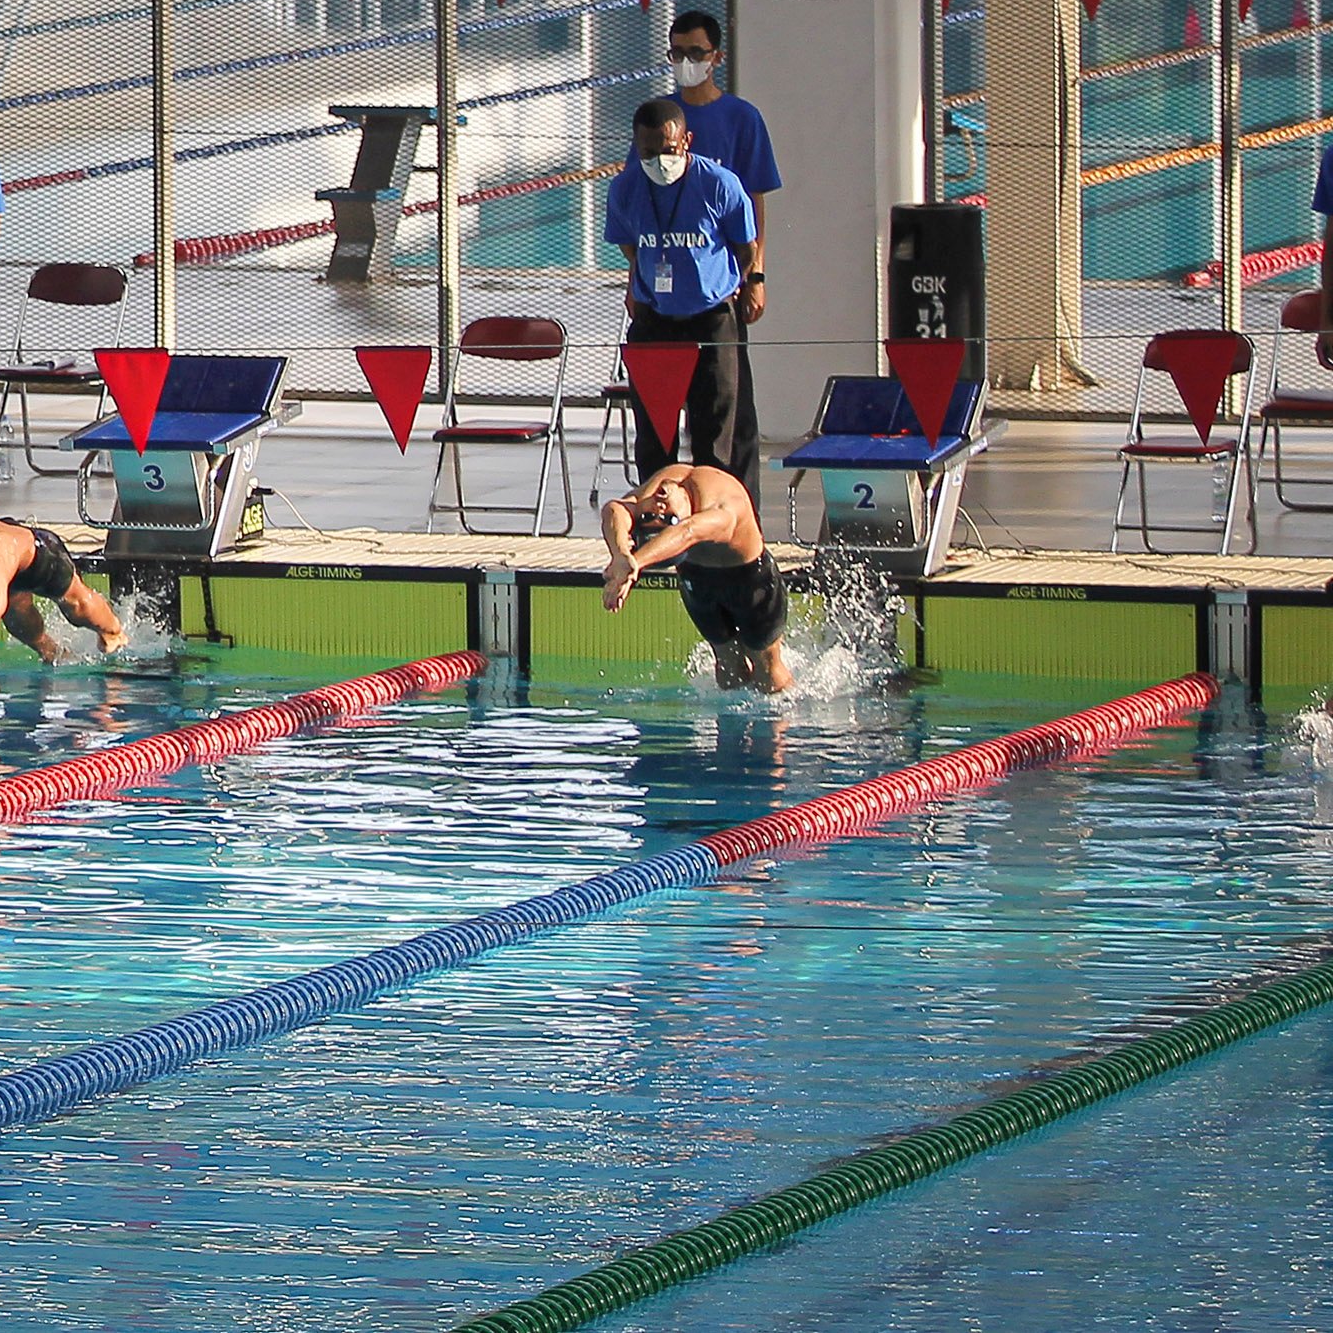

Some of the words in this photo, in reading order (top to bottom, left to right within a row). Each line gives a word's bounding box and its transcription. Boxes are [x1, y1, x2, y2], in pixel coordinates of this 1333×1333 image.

[638, 233, 657, 248] AB
[662, 232, 706, 248] SWIM
[911, 275, 947, 294] GBK
[143, 463, 166, 492] 3
[853, 481, 877, 511] 2
